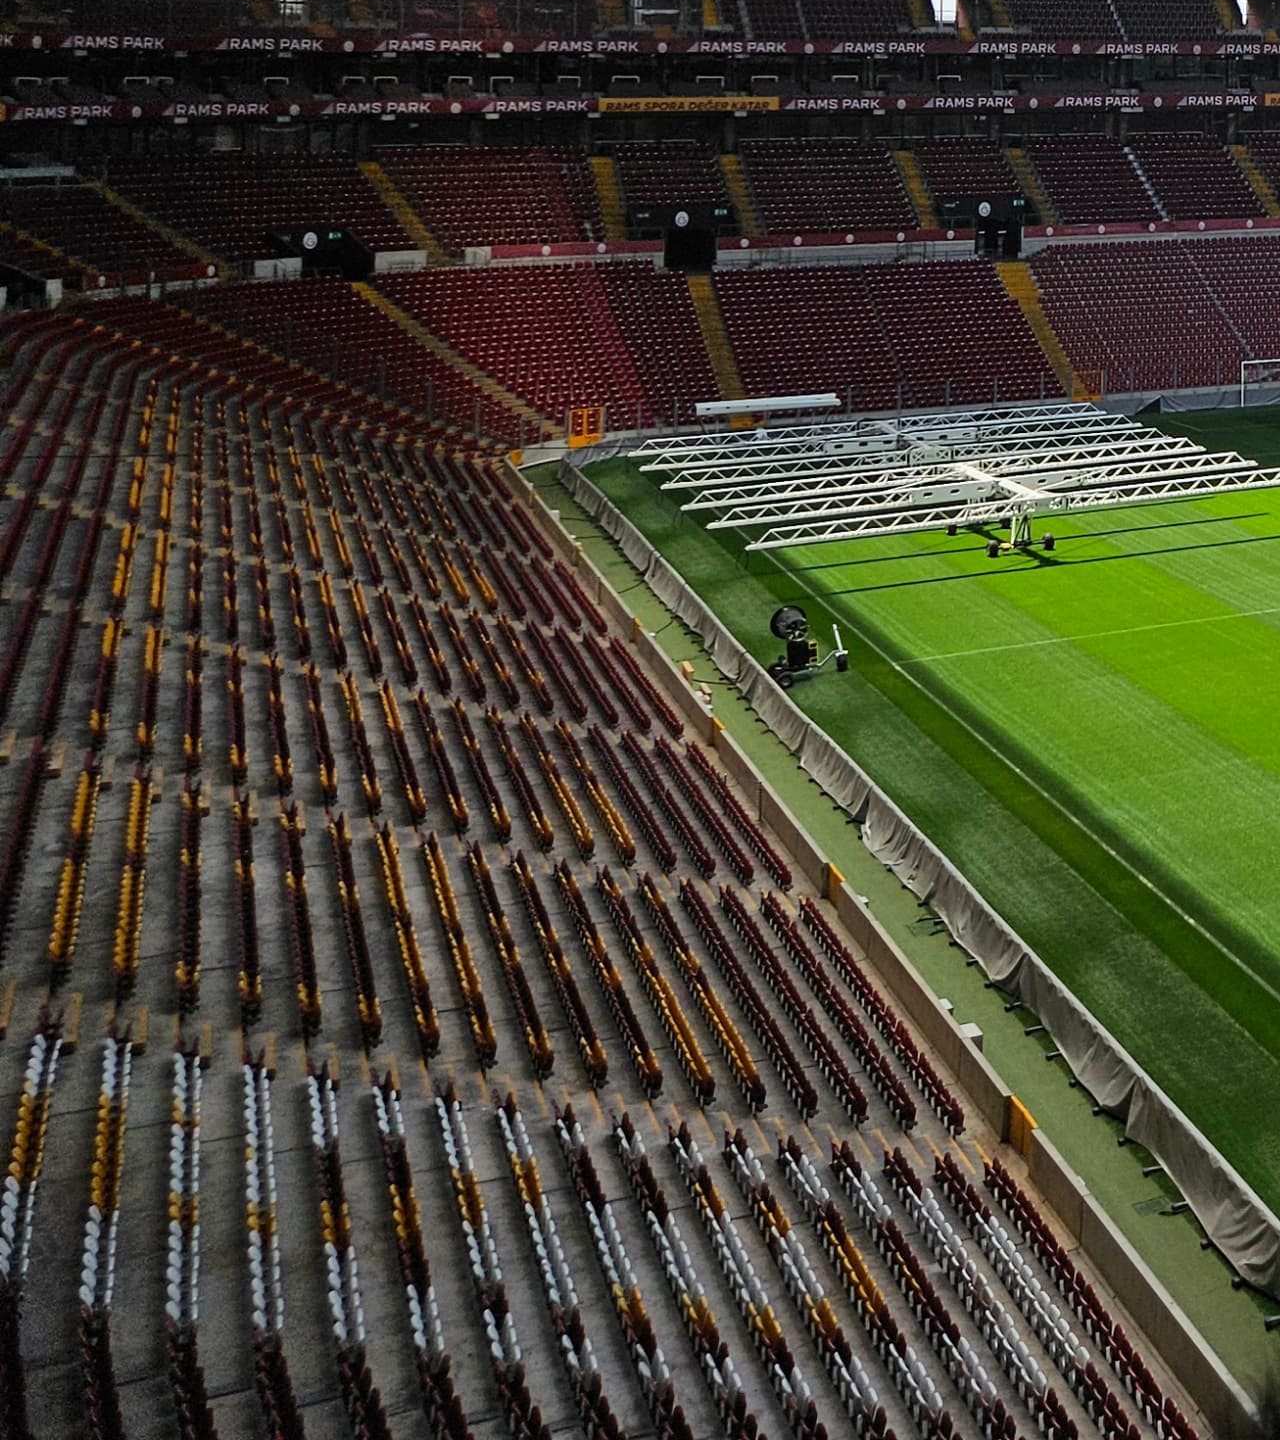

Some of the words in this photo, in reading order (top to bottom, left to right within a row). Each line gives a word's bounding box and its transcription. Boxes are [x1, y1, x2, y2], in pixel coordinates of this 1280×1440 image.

[74, 36, 120, 49] RAMS
[124, 36, 164, 49] PARK
[230, 38, 274, 50] RAMS
[279, 39, 322, 51] PARK
[388, 40, 435, 51] RAMS
[440, 40, 482, 52] PARK
[548, 41, 594, 52] RAMS
[598, 41, 639, 52] PARK
[700, 42, 742, 53] RAMS
[747, 42, 786, 53] PARK
[844, 42, 884, 53] RAMS
[889, 42, 925, 53] PARK
[980, 43, 1018, 53] RAMS
[1022, 43, 1056, 54] PARK
[1107, 44, 1142, 54] RAMS
[1146, 44, 1178, 54] PARK
[1227, 44, 1260, 54] RAMS
[496, 101, 541, 112] RAMS
[546, 100, 588, 111] PARK
[798, 99, 838, 110] RAMS
[842, 99, 880, 109] PARK
[936, 98, 974, 108] RAMS
[978, 98, 1014, 107] PARK
[1066, 97, 1101, 107] RAMS
[1106, 96, 1138, 106] PARK
[1188, 96, 1222, 106] RAMS
[1226, 96, 1257, 105] PARK
[25, 106, 64, 119] RAMS
[72, 106, 112, 117] PARK
[176, 104, 222, 116] RAMS
[226, 104, 270, 115] PARK
[336, 102, 382, 114] RAMS
[388, 102, 430, 113] PARK
